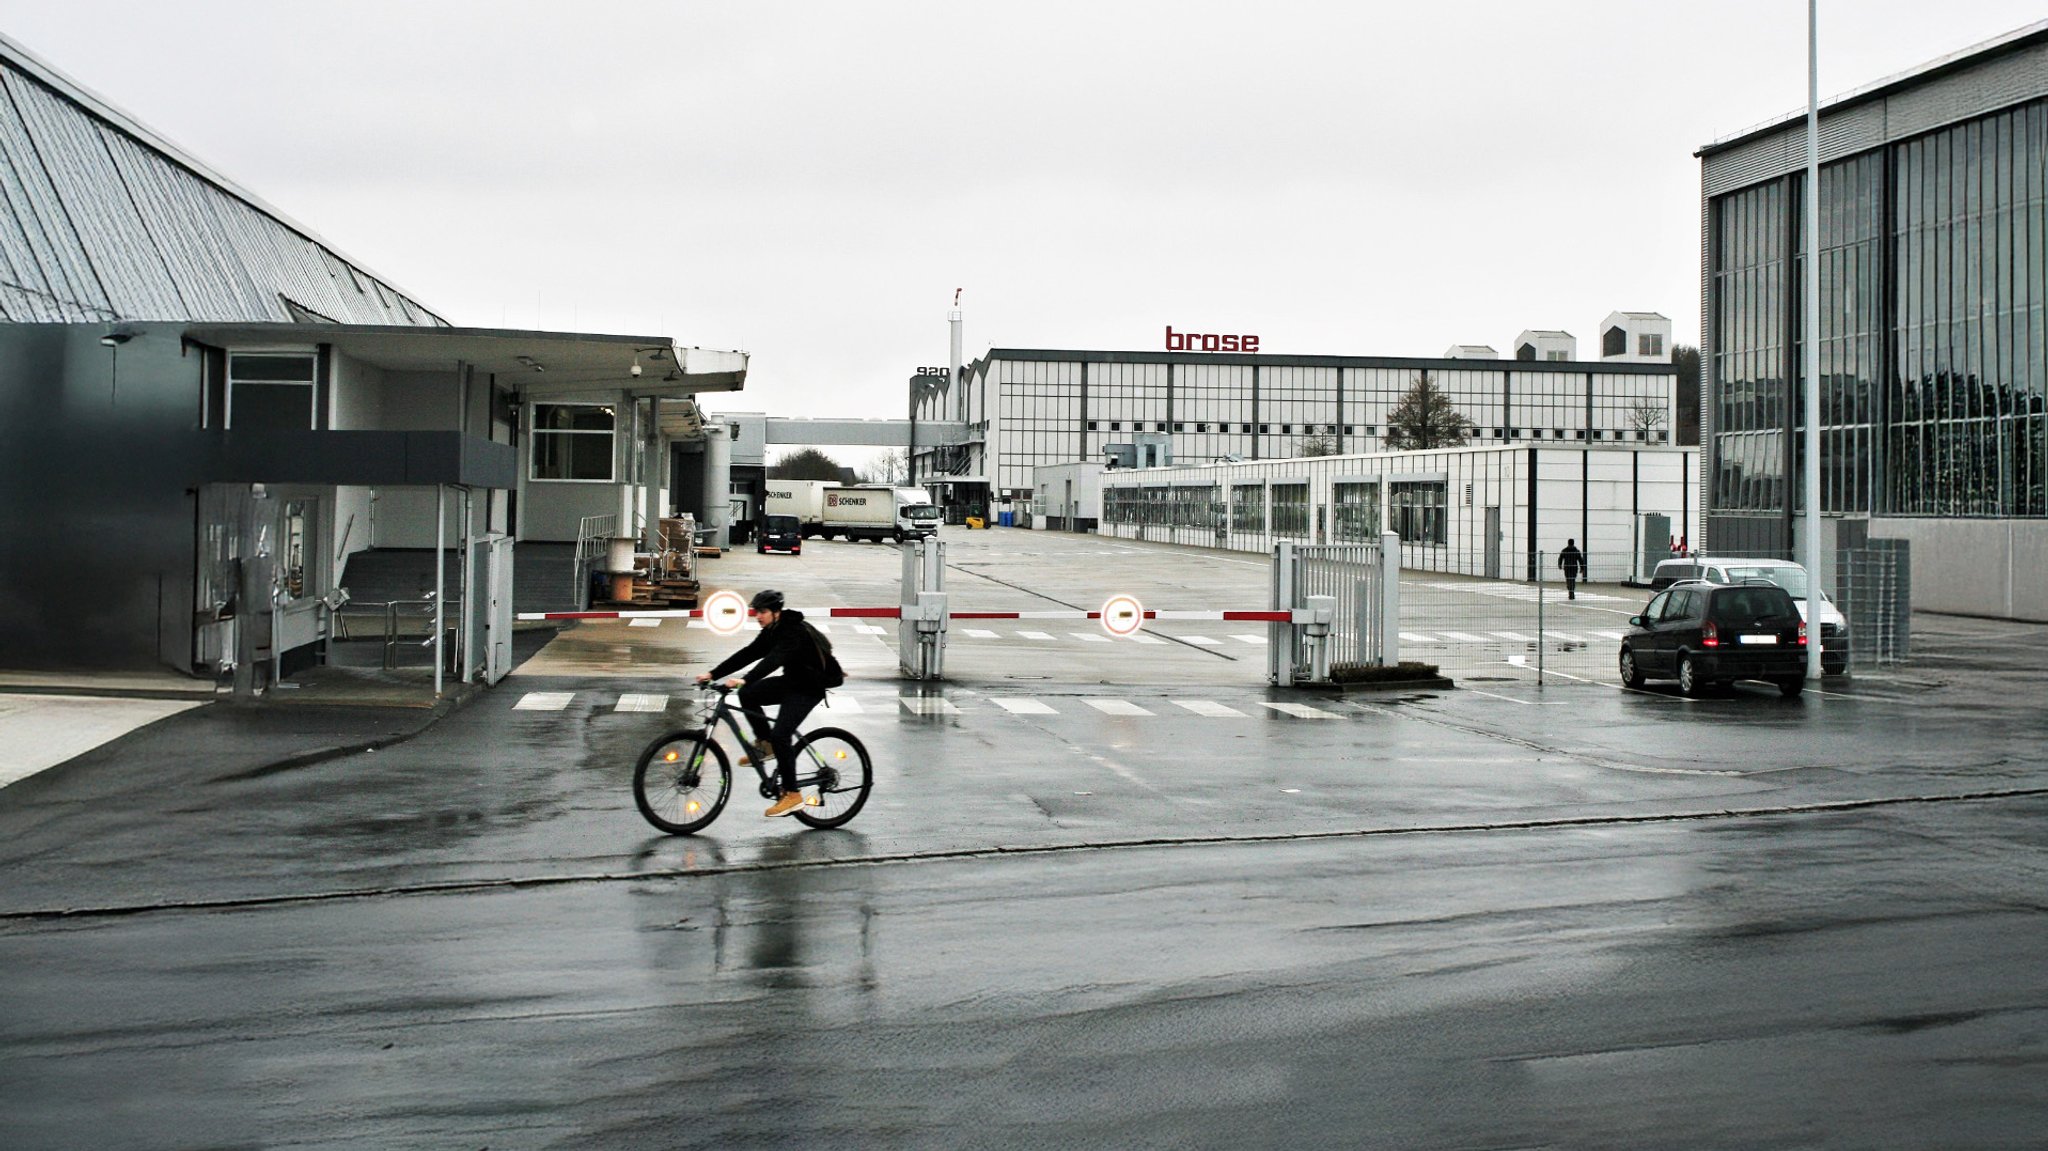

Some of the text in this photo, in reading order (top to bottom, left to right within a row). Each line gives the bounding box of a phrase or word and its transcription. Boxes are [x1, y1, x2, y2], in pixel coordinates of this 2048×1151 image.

[1165, 325, 1260, 352] brose
[916, 366, 950, 377] 920
[767, 491, 793, 499] SCHENKER
[838, 497, 867, 506] SCHENKER
